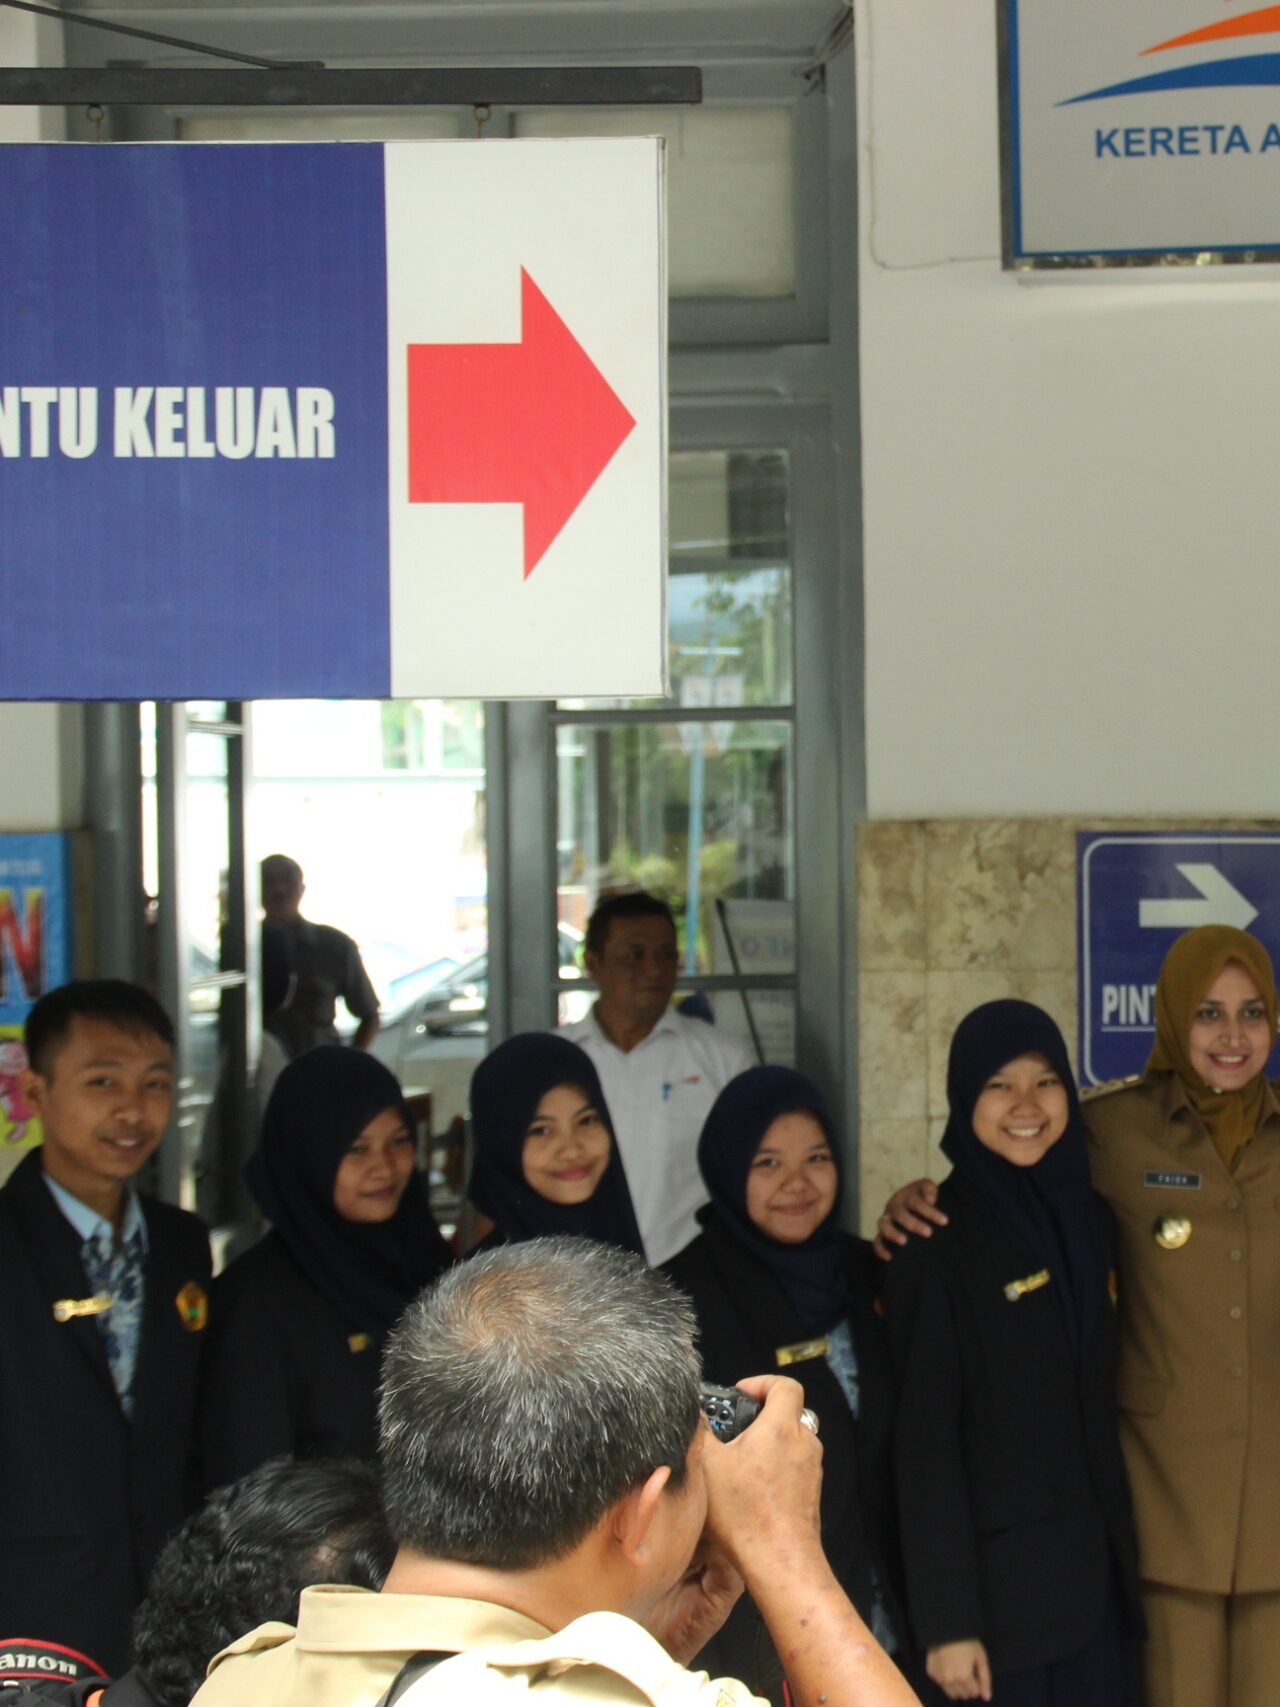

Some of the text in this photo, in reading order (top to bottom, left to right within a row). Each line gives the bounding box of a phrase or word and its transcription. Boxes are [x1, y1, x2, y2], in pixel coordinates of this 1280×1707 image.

[1095, 124, 1251, 158] KERETA
[114, 387, 336, 459] KELUAR
[1102, 984, 1157, 1025] PIN
